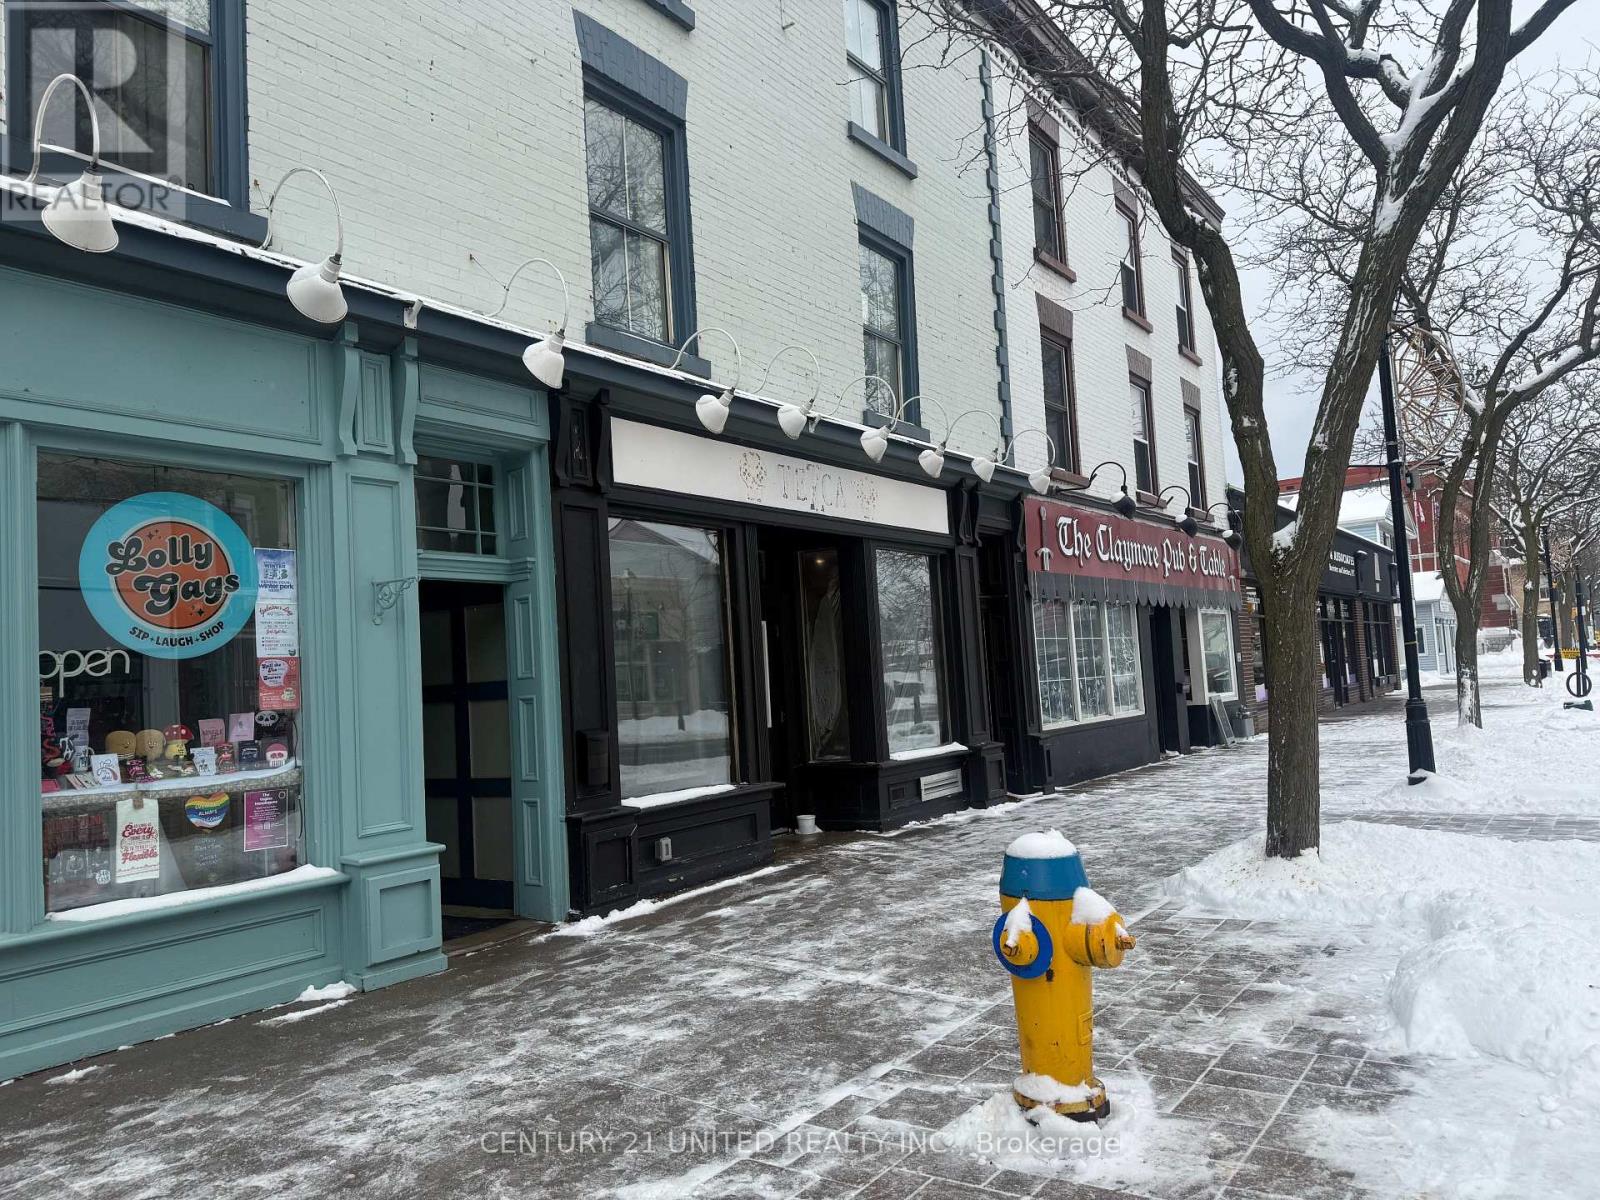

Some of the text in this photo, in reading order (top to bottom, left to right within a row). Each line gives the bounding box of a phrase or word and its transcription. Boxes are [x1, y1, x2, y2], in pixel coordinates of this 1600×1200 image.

[106, 534, 213, 575] Lolly
[1057, 516, 1226, 578] The Claymore Pub & Table
[133, 573, 240, 616] Gags
[129, 621, 225, 647] SIP LAUGH SHOP
[39, 649, 130, 698] open
